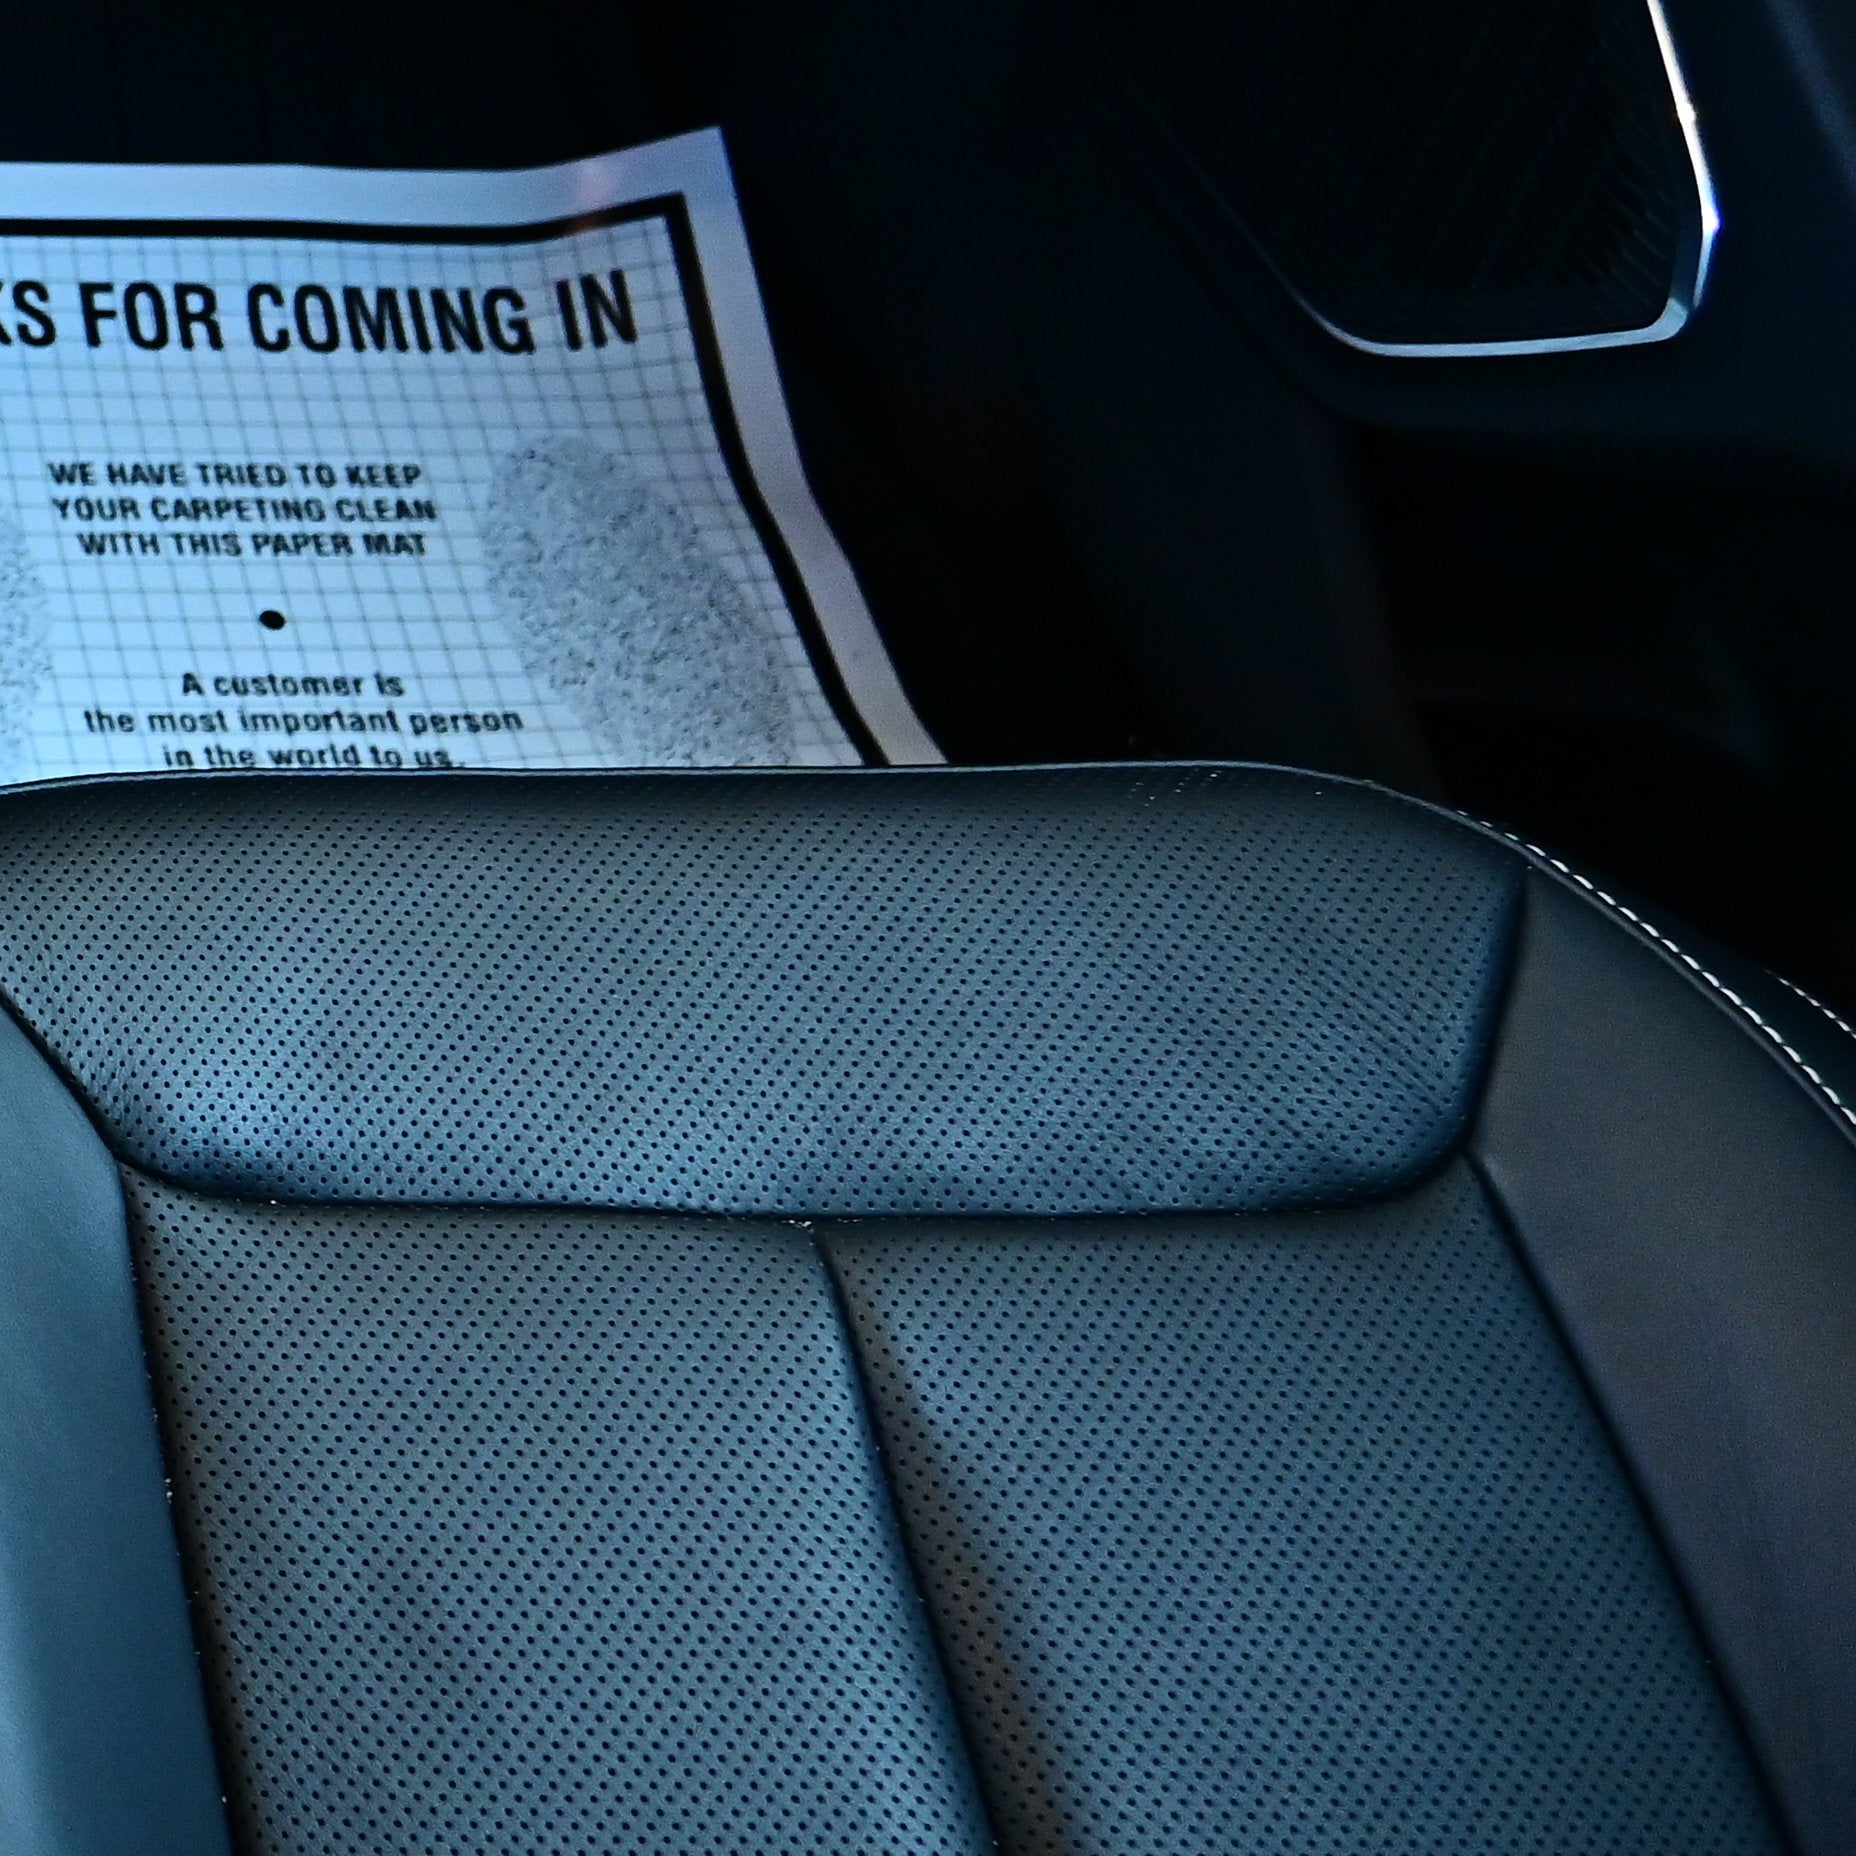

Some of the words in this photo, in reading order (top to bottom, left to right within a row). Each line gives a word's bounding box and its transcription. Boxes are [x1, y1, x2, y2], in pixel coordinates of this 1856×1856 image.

[83, 280, 224, 352] FOR
[247, 282, 536, 356] COMING
[556, 269, 640, 350] IN
[48, 461, 95, 486] WE
[107, 461, 186, 487] HAVE
[195, 461, 286, 487] TRIED
[296, 461, 337, 488] TO
[345, 462, 421, 488] KEEP
[51, 497, 141, 522] YOUR
[151, 496, 326, 522] CARPETING
[335, 497, 437, 522] CLEAN
[77, 532, 160, 556] WITH
[170, 532, 242, 556] THIS
[251, 532, 353, 556] PAPER
[362, 532, 428, 556] MAT
[182, 672, 203, 696] A
[213, 673, 363, 697] customer
[375, 671, 405, 697] is
[84, 709, 135, 734] the
[147, 709, 228, 733] most
[239, 709, 400, 736] important
[409, 709, 524, 736] person
[163, 745, 193, 768] in
[203, 744, 256, 768] the
[266, 744, 361, 768] world
[370, 744, 403, 769] to
